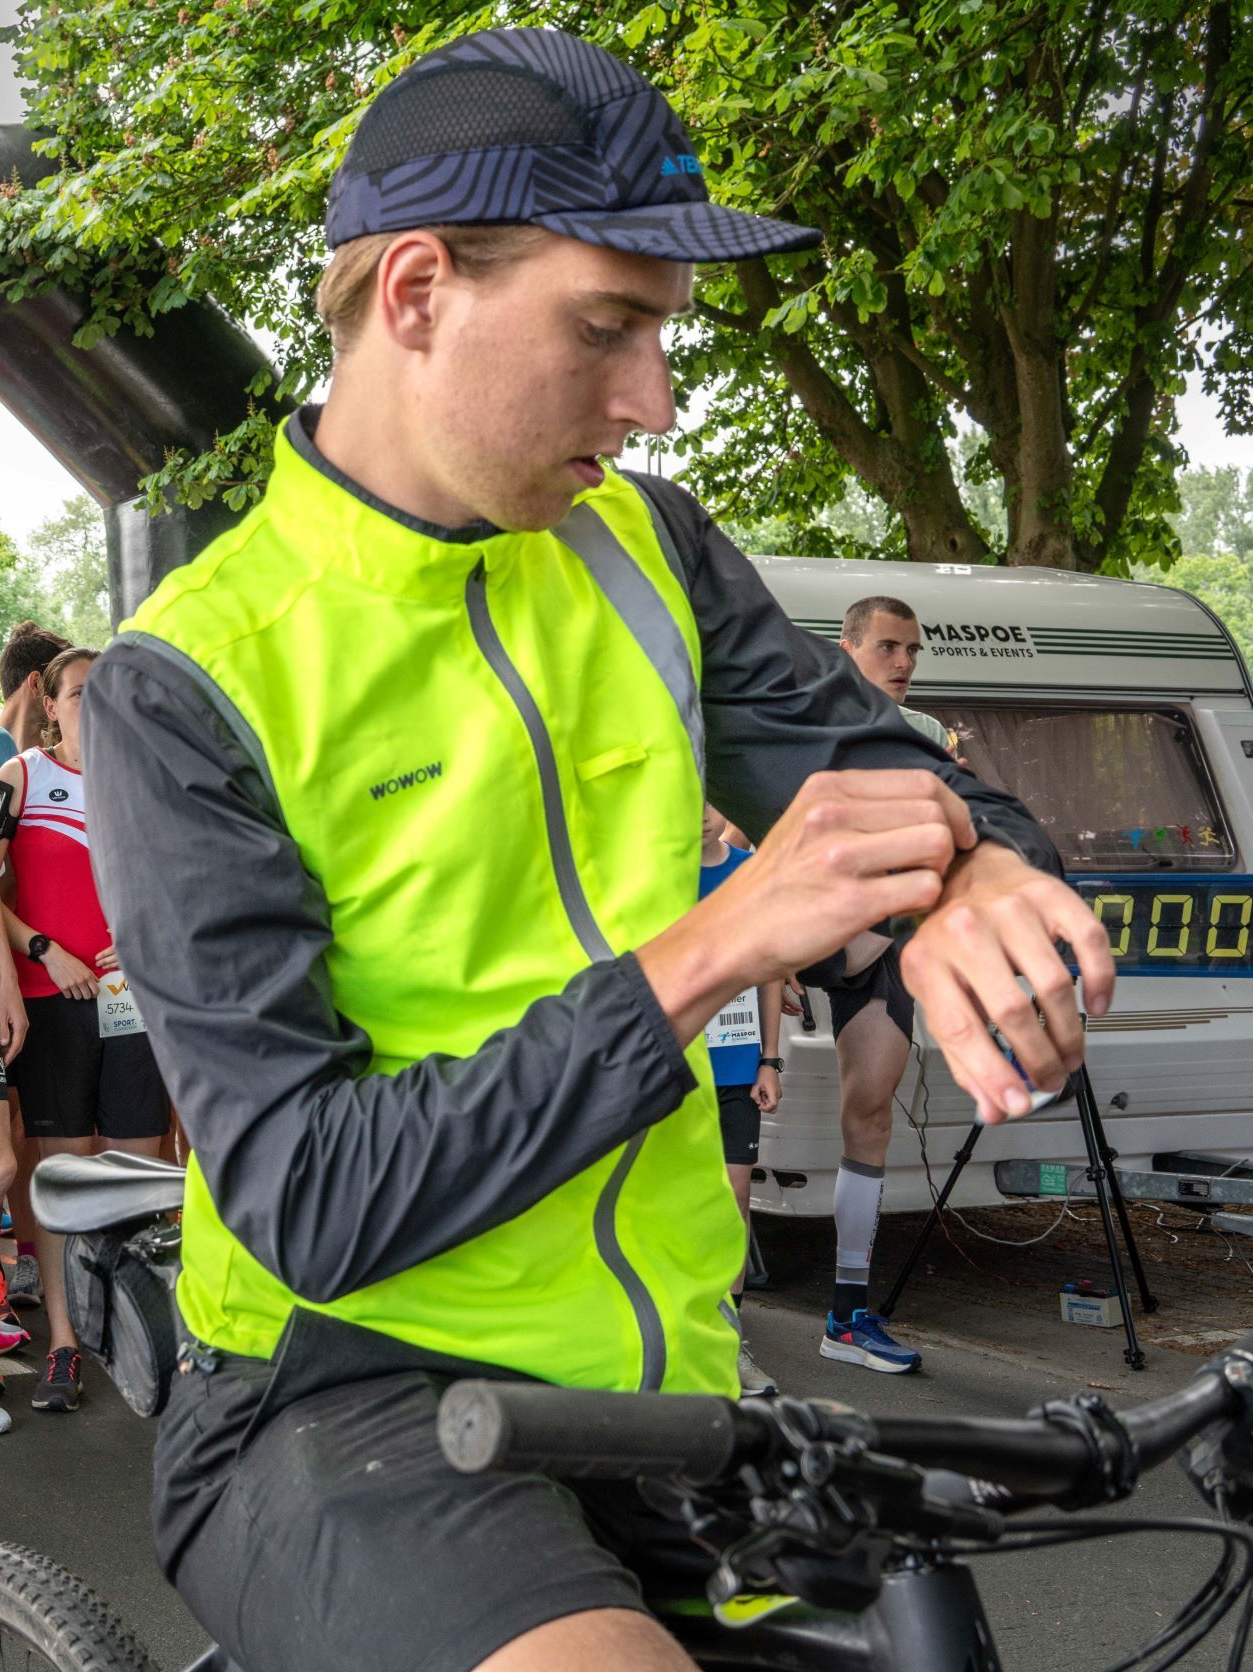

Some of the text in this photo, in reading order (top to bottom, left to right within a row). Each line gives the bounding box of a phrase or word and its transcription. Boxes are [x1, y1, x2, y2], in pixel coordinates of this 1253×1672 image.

[921, 623, 1027, 643] MASPOE
[931, 646, 1034, 658] SPORTS & EVENTS
[369, 761, 442, 801] WOWOW
